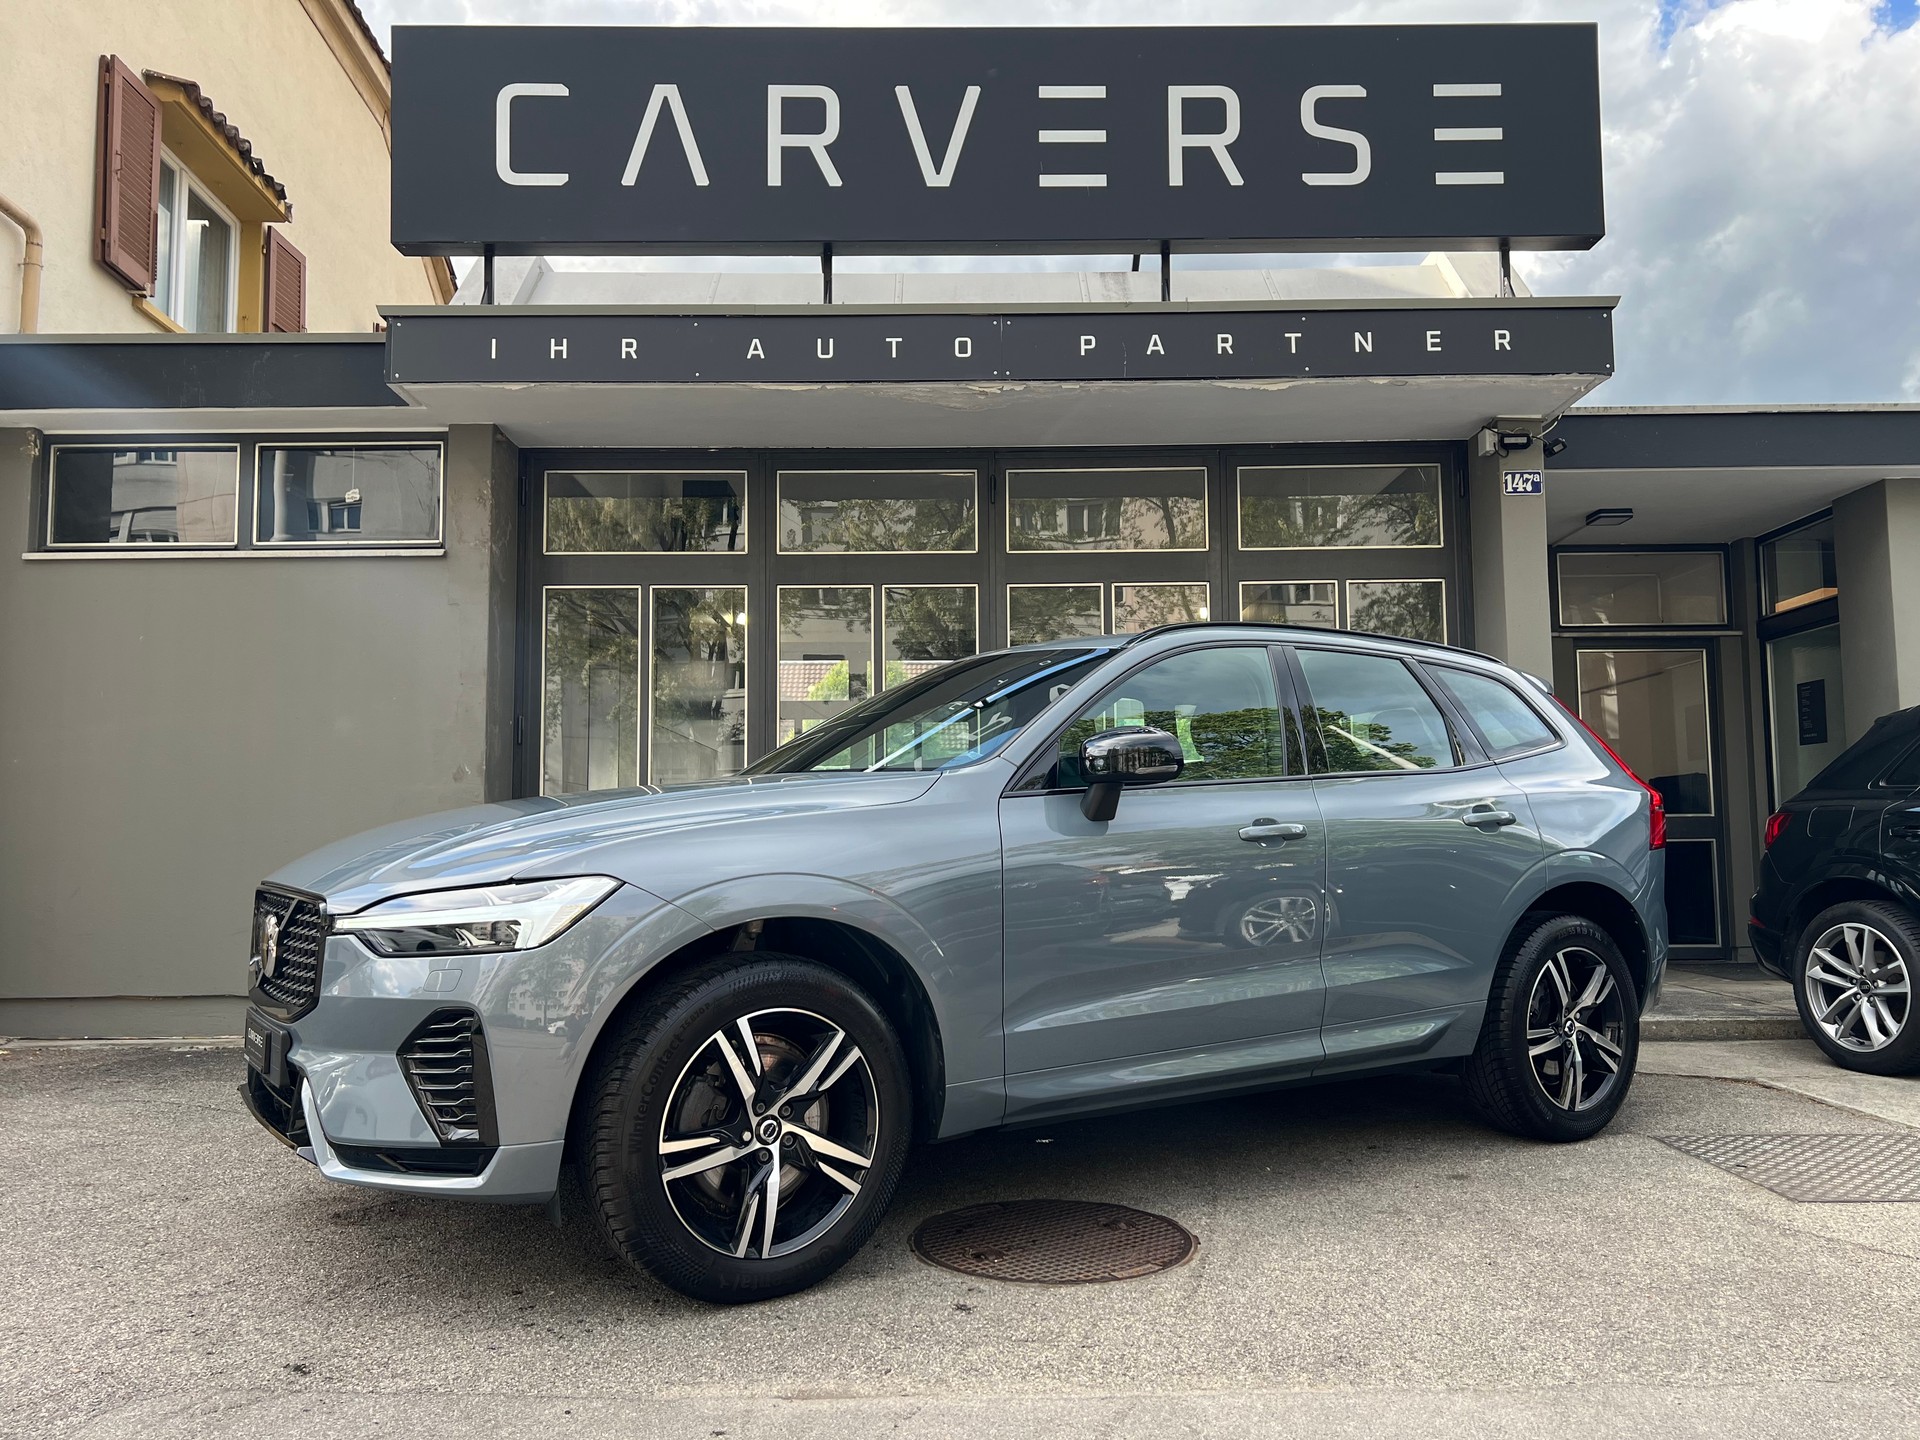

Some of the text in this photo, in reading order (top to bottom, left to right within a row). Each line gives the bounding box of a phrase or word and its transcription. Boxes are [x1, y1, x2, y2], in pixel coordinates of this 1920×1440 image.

[495, 82, 1505, 187] CARVERSE
[491, 329, 1512, 360] IHR AUTO PARTNER
[1504, 473, 1540, 492] 147a
[628, 1032, 686, 1155] WinterContact
